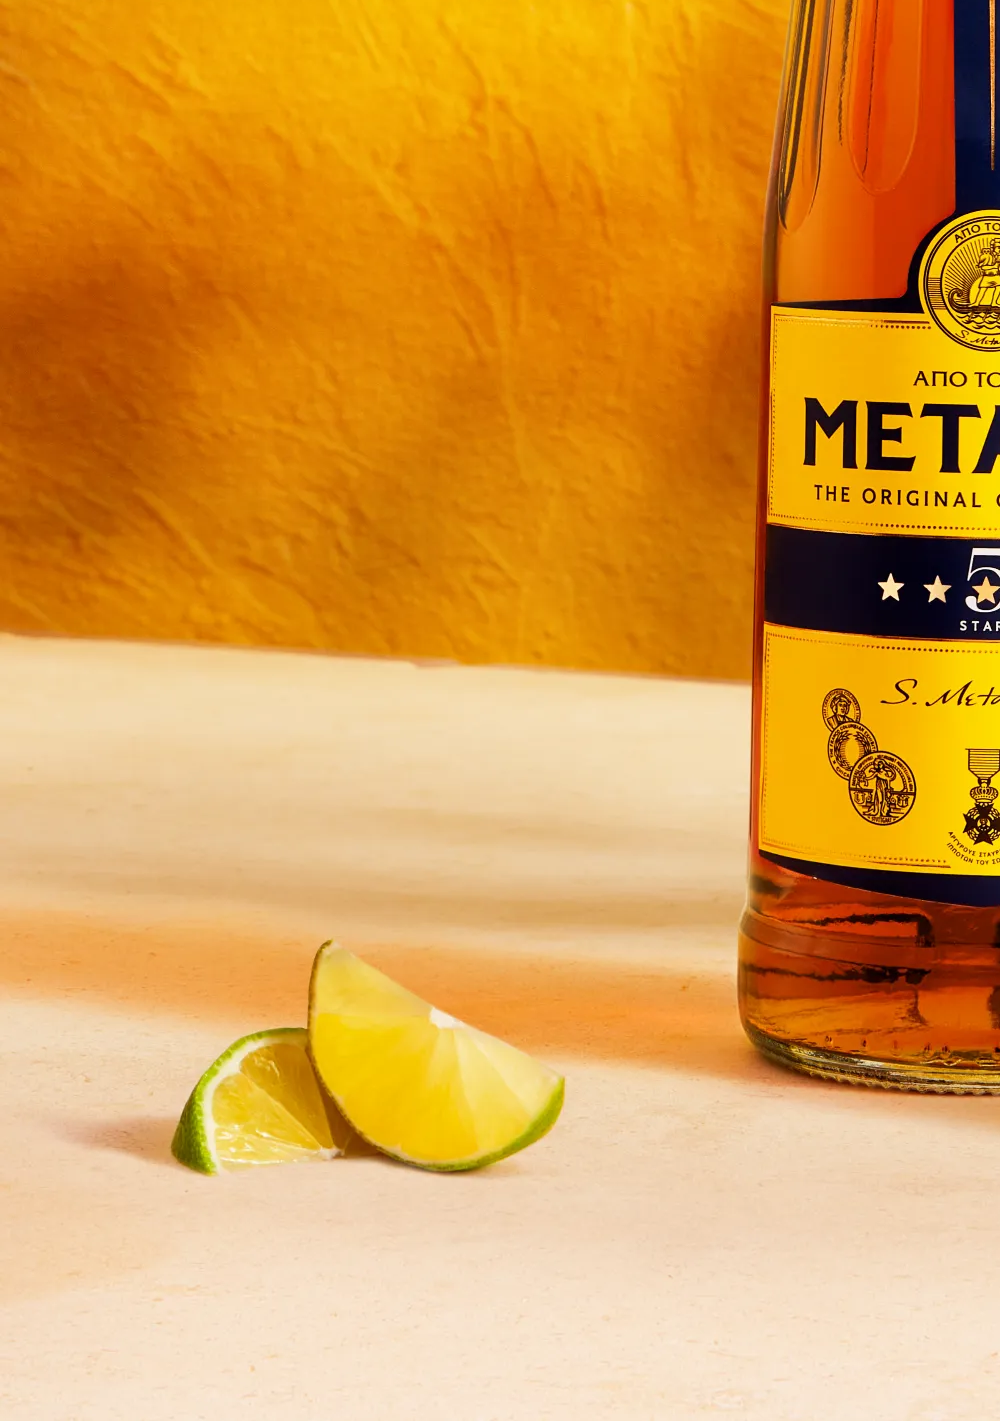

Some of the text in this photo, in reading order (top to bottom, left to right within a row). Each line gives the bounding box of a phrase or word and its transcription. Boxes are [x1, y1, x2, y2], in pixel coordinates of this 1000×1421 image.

[912, 370, 968, 388] ΑΠΟ
[814, 484, 851, 503] THE
[862, 487, 982, 509] ORIGINAL
